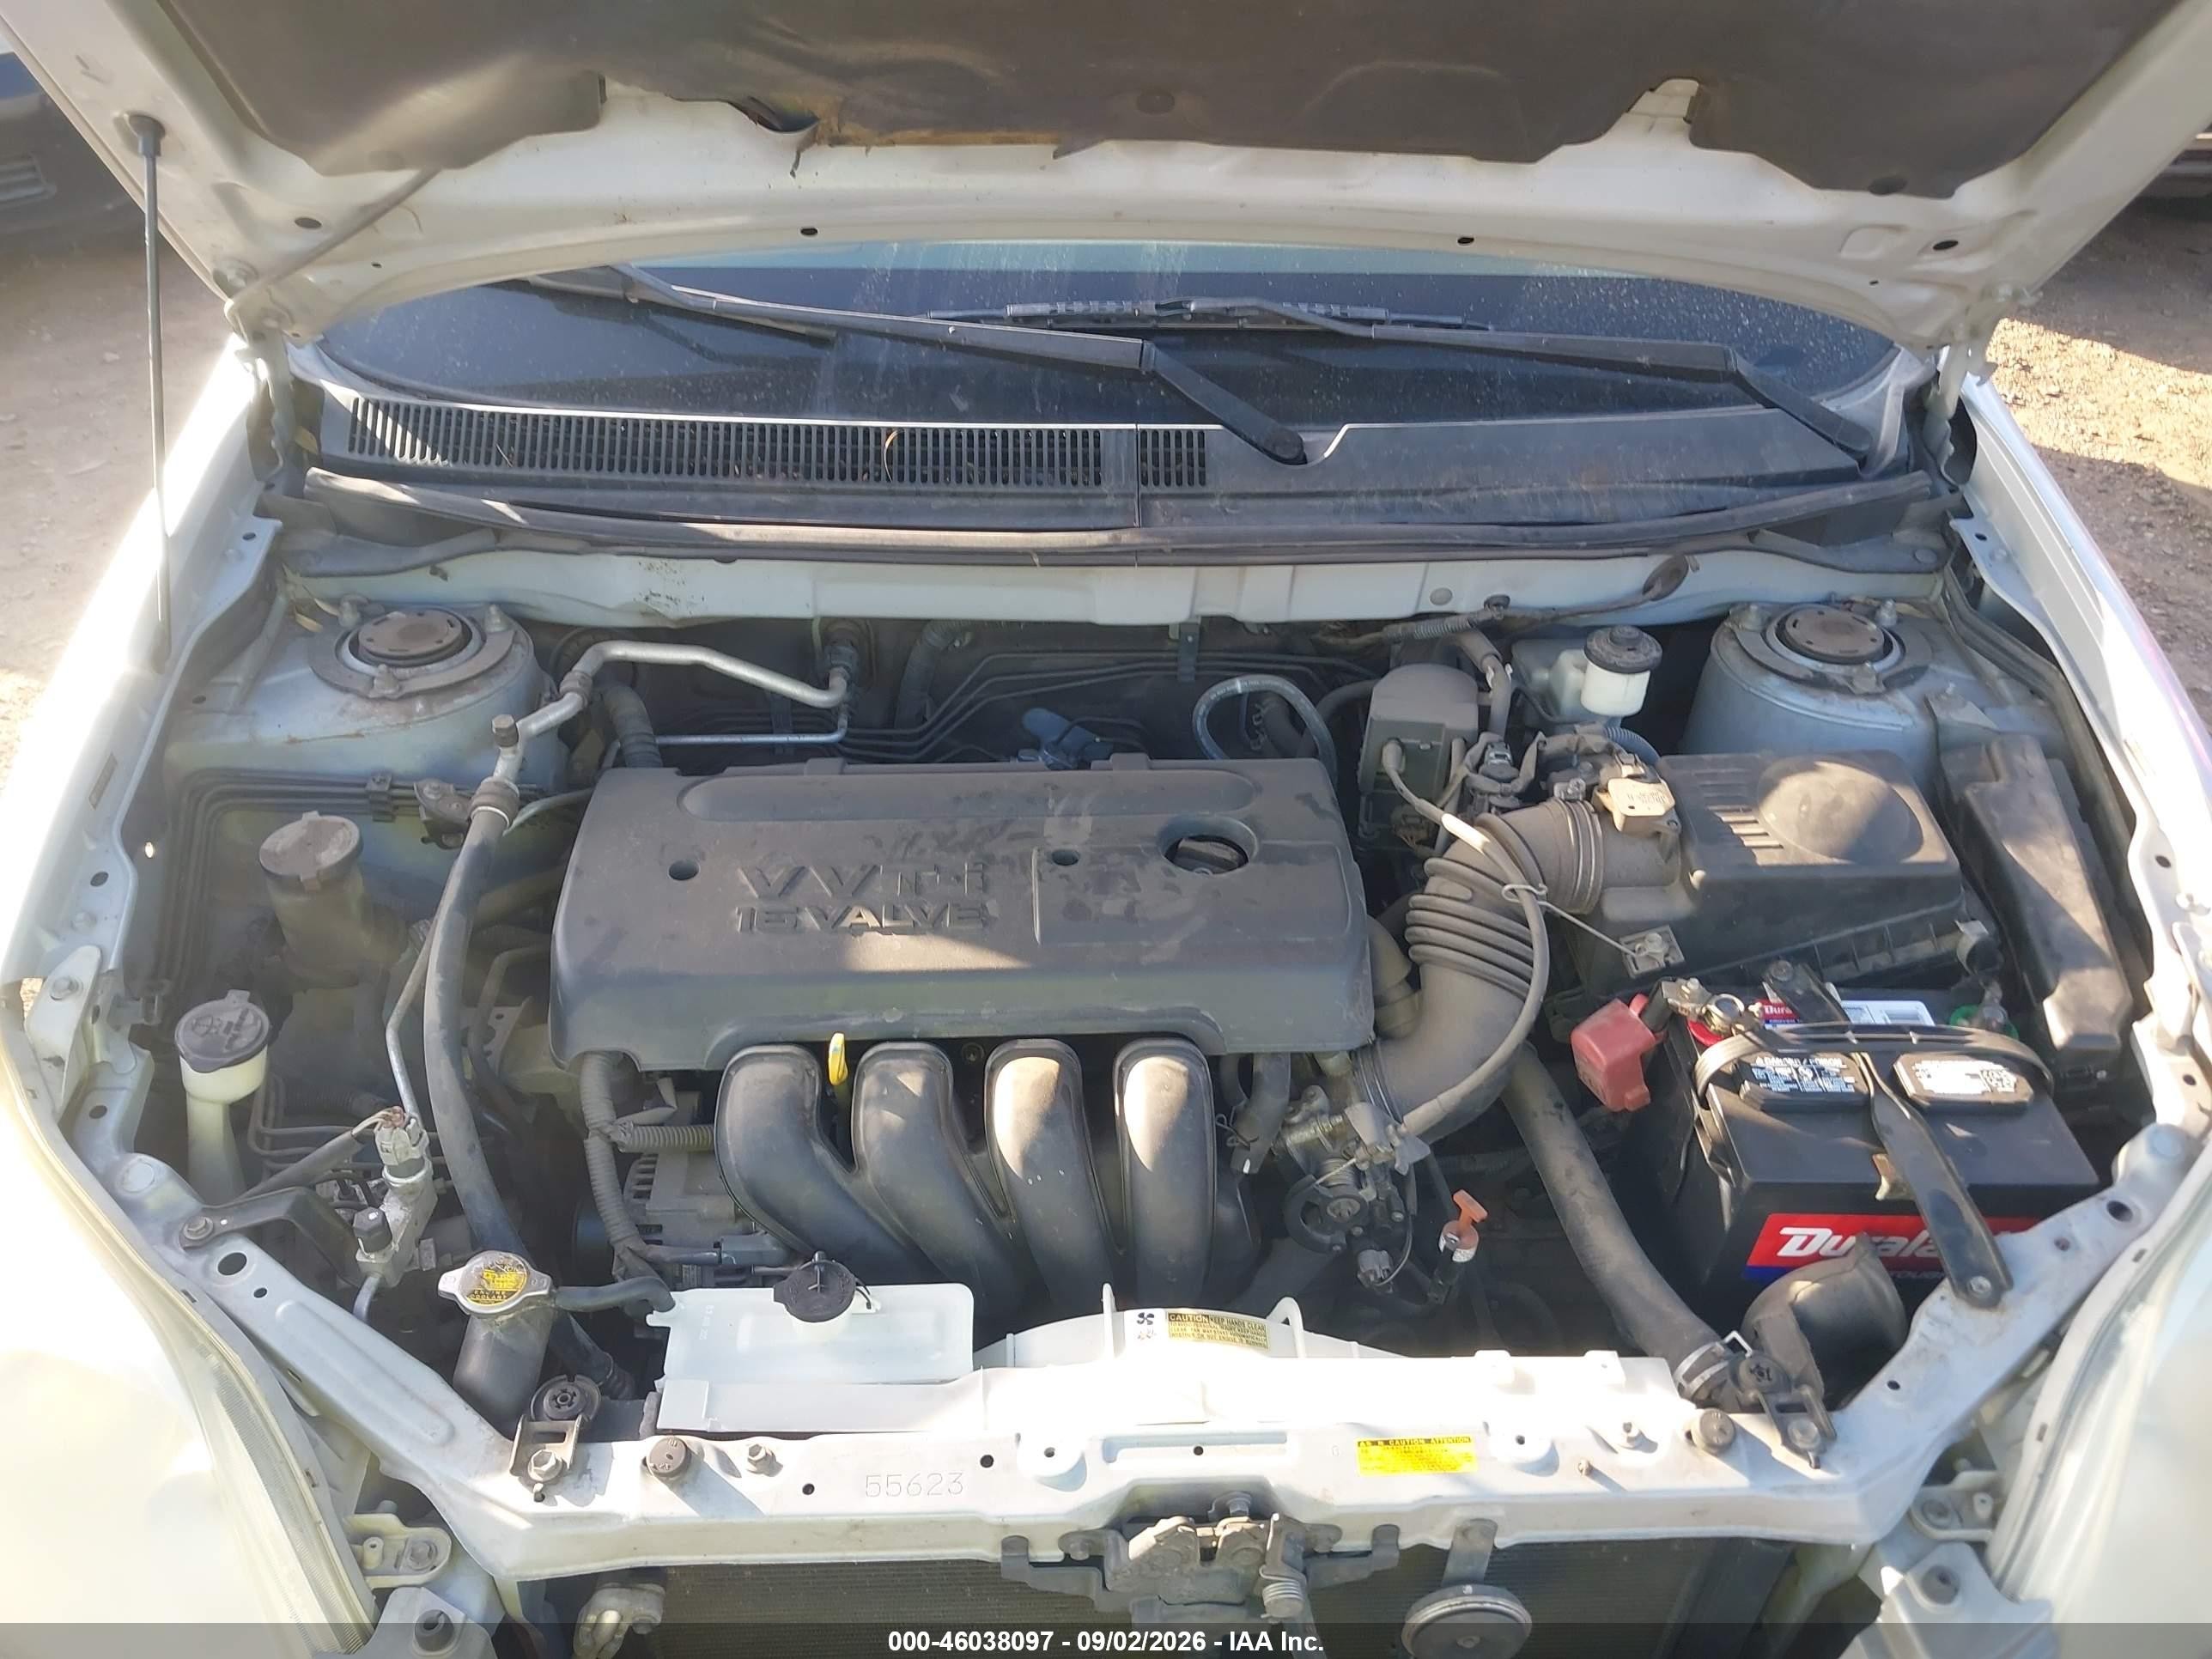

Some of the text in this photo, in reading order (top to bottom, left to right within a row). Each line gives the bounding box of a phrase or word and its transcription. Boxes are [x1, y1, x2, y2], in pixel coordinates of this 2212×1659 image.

[804, 903, 986, 931] VALVE
[1170, 1314, 1209, 1323] CAUTION
[1227, 1317, 1246, 1328] HANDS
[1247, 1321, 1266, 1332] CLEAR
[865, 1472, 964, 1498] 55623
